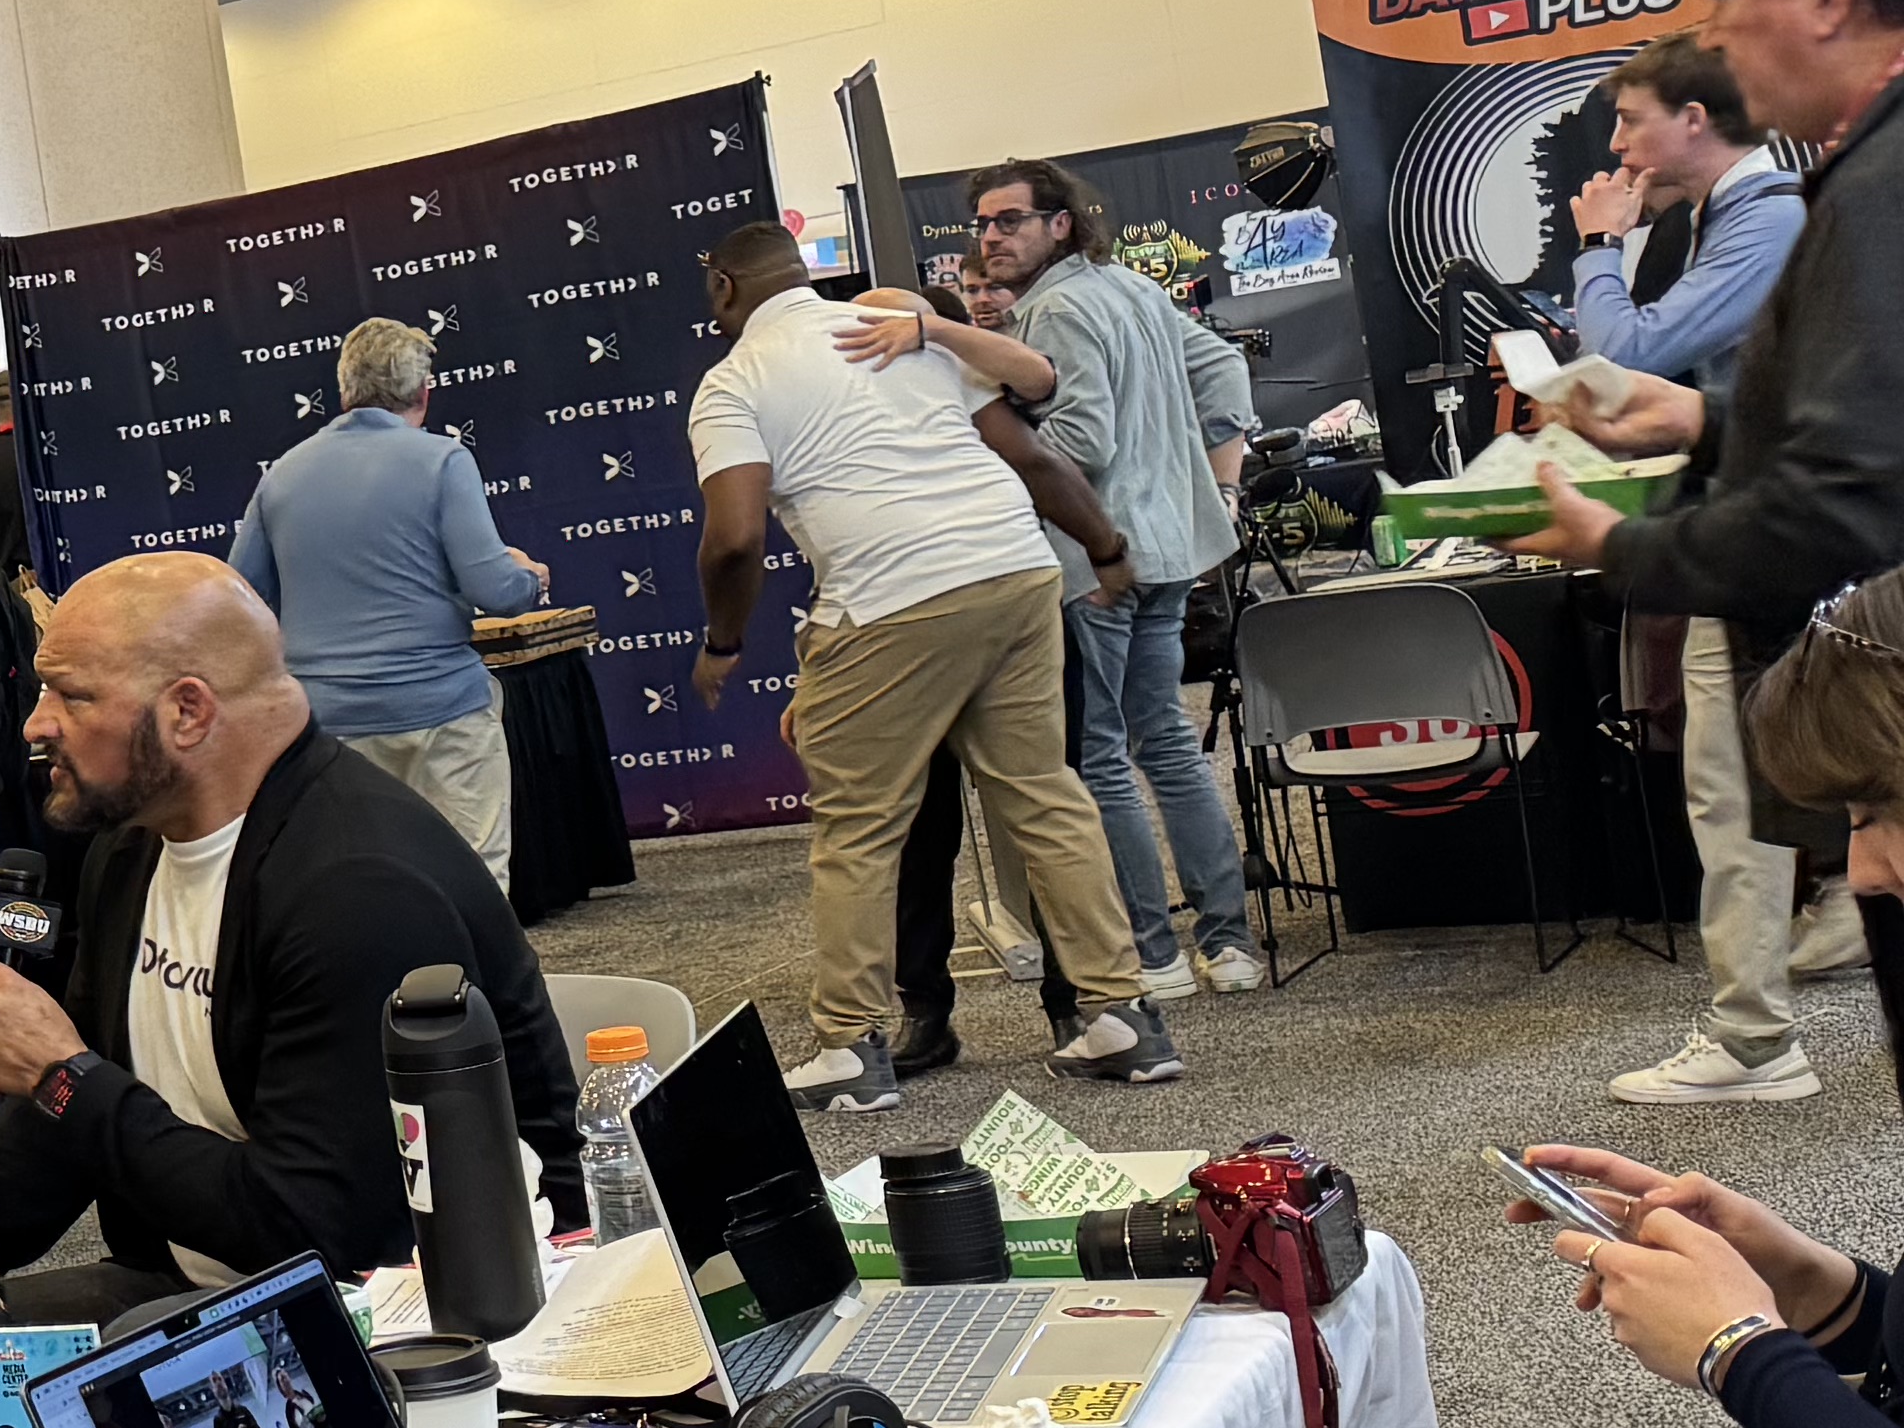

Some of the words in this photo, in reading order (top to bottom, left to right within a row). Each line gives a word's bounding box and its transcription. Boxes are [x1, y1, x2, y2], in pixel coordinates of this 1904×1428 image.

[671, 188, 754, 220] TOGET
[1190, 183, 1250, 205] ICO
[973, 1098, 1017, 1152] BOUNTY
[1046, 1156, 1094, 1213] BOUNTY
[846, 1236, 895, 1258] Win
[1005, 1236, 1072, 1256] ounty
